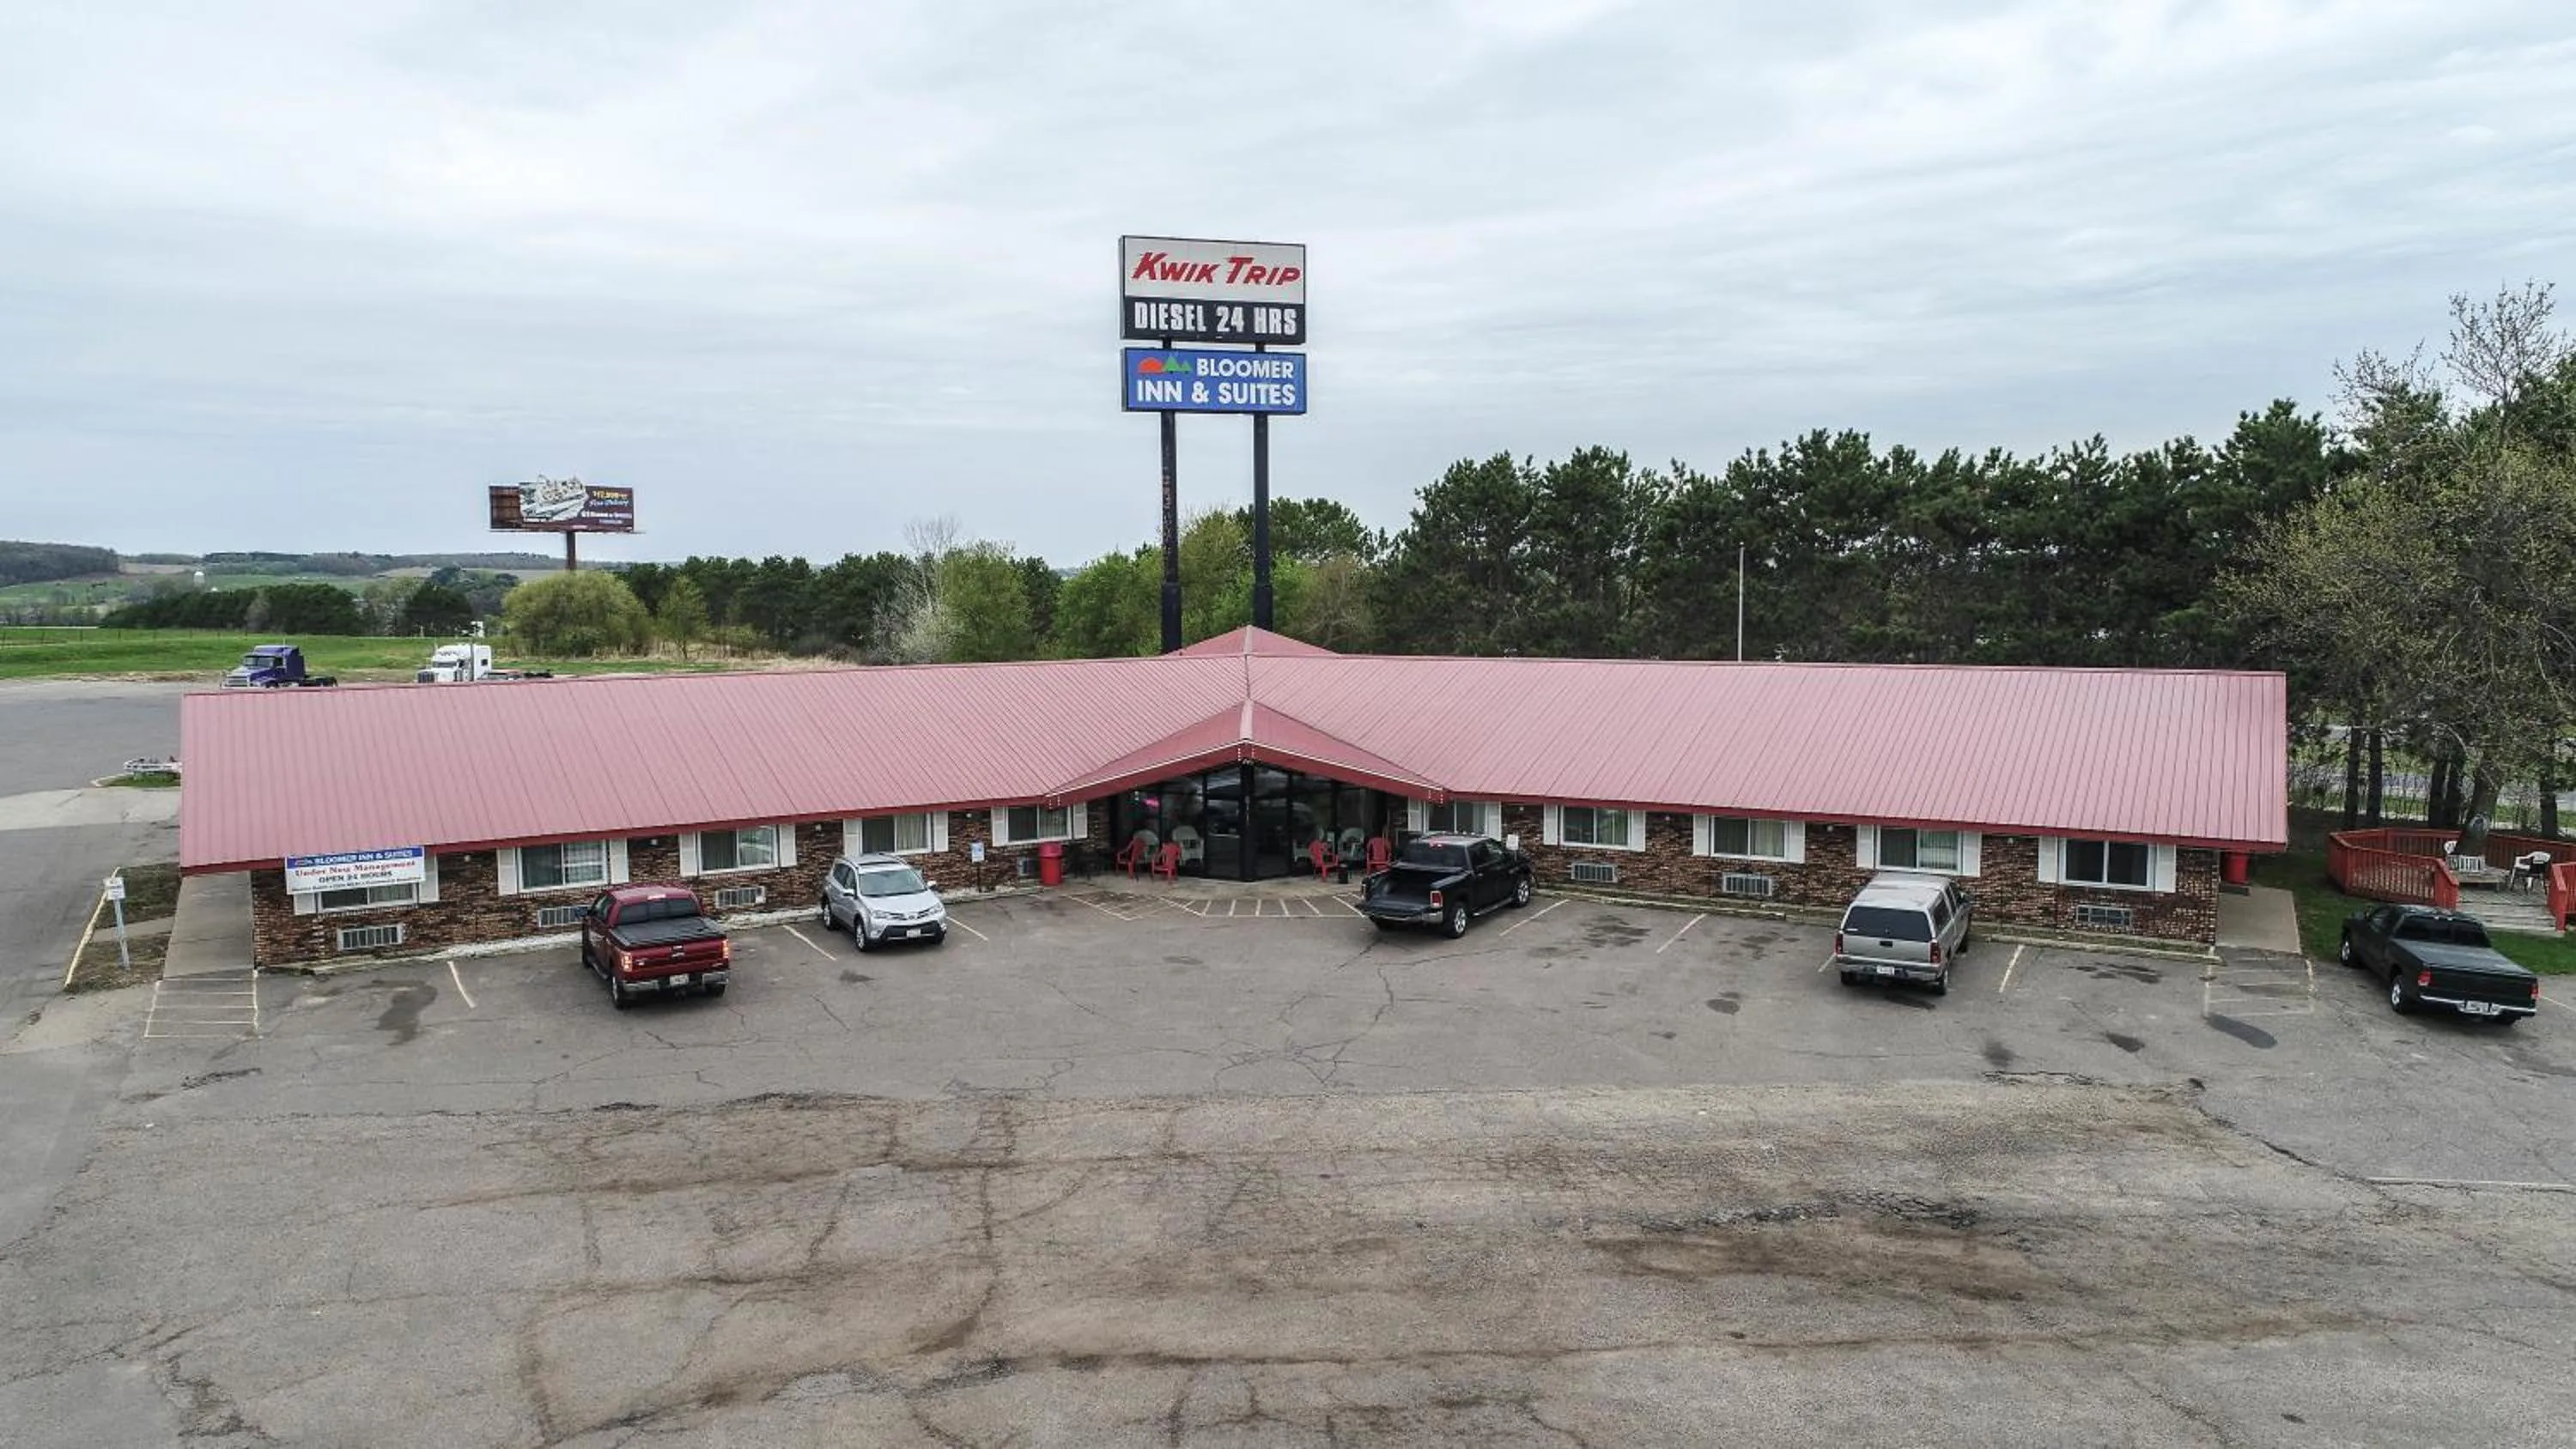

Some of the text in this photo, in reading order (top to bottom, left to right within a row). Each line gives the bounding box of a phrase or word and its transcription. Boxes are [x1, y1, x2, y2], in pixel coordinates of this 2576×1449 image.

[1132, 252, 1301, 285] KWIK TRIP
[1134, 302, 1297, 335] DIESEL 24 HRS
[1196, 358, 1294, 379] BLOOMER
[1137, 380, 1296, 405] INN & SUITES
[316, 854, 357, 865] BLOOMER
[358, 852, 374, 861] INN
[330, 865, 350, 875] New
[355, 860, 415, 872] Management
